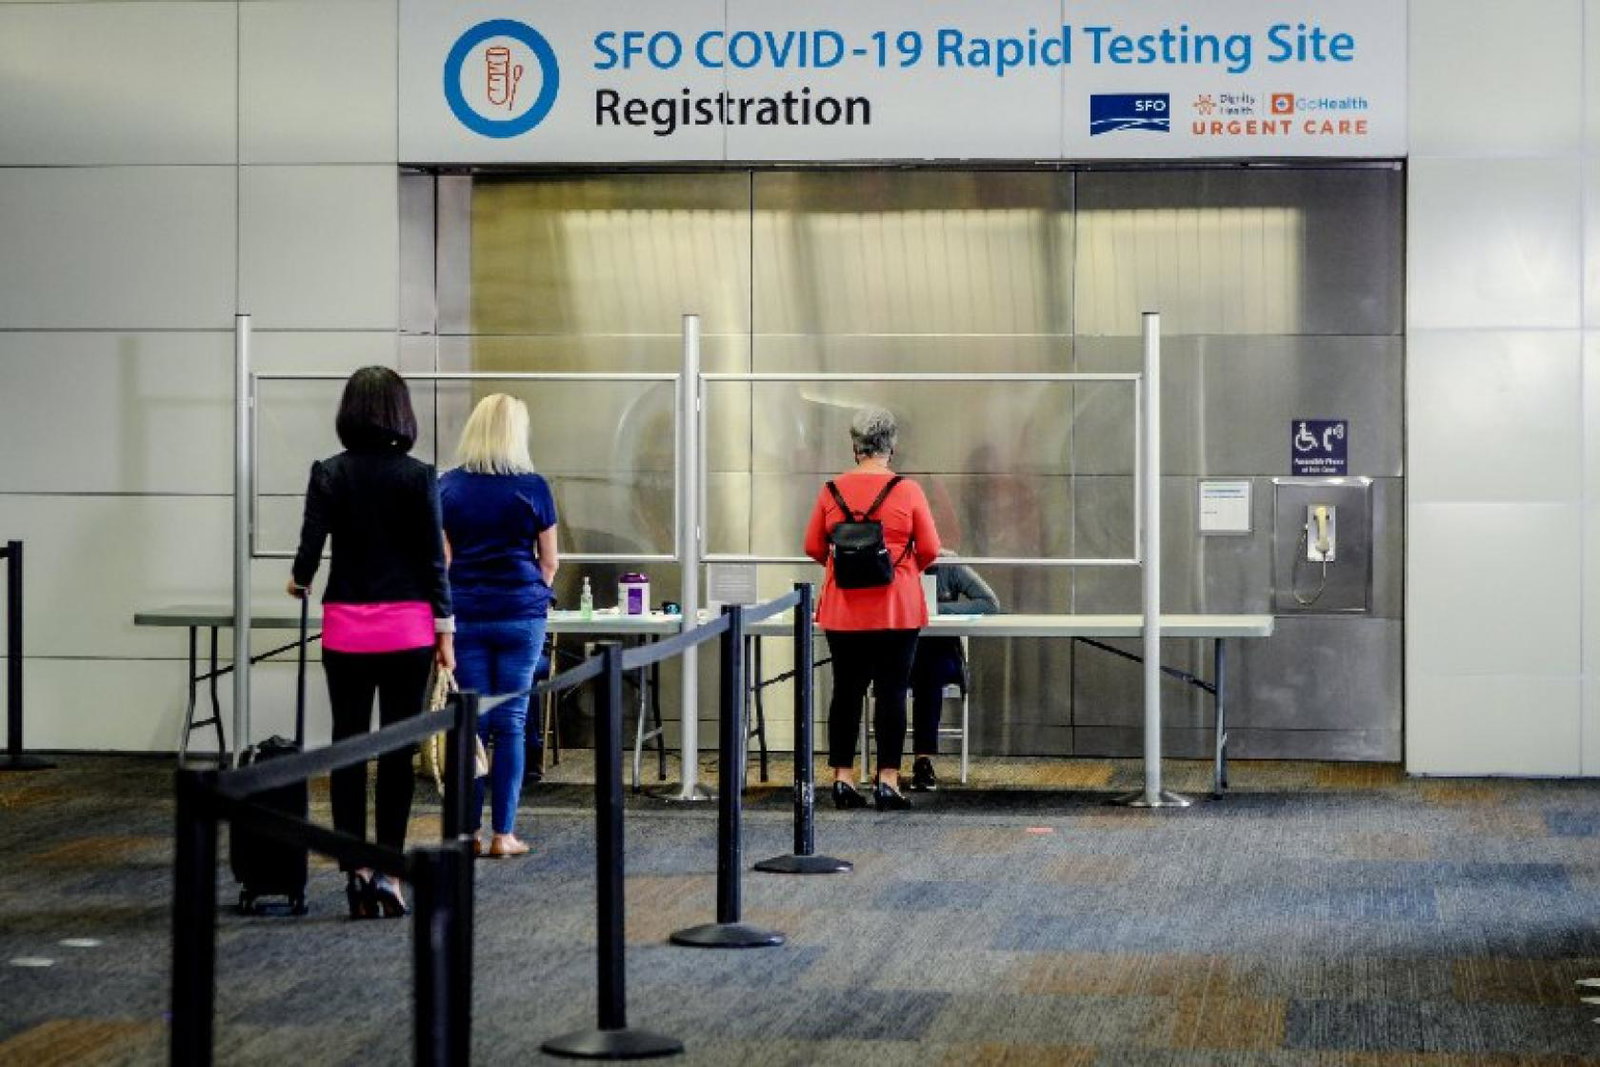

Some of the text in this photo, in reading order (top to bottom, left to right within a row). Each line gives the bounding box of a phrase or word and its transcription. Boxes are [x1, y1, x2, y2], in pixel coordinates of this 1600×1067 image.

[593, 23, 1355, 77] SFO COVID-19 Rapid Testing Site
[595, 86, 871, 137] Registration
[1135, 99, 1167, 112] SFO
[1192, 120, 1368, 135] URGENT CARE
